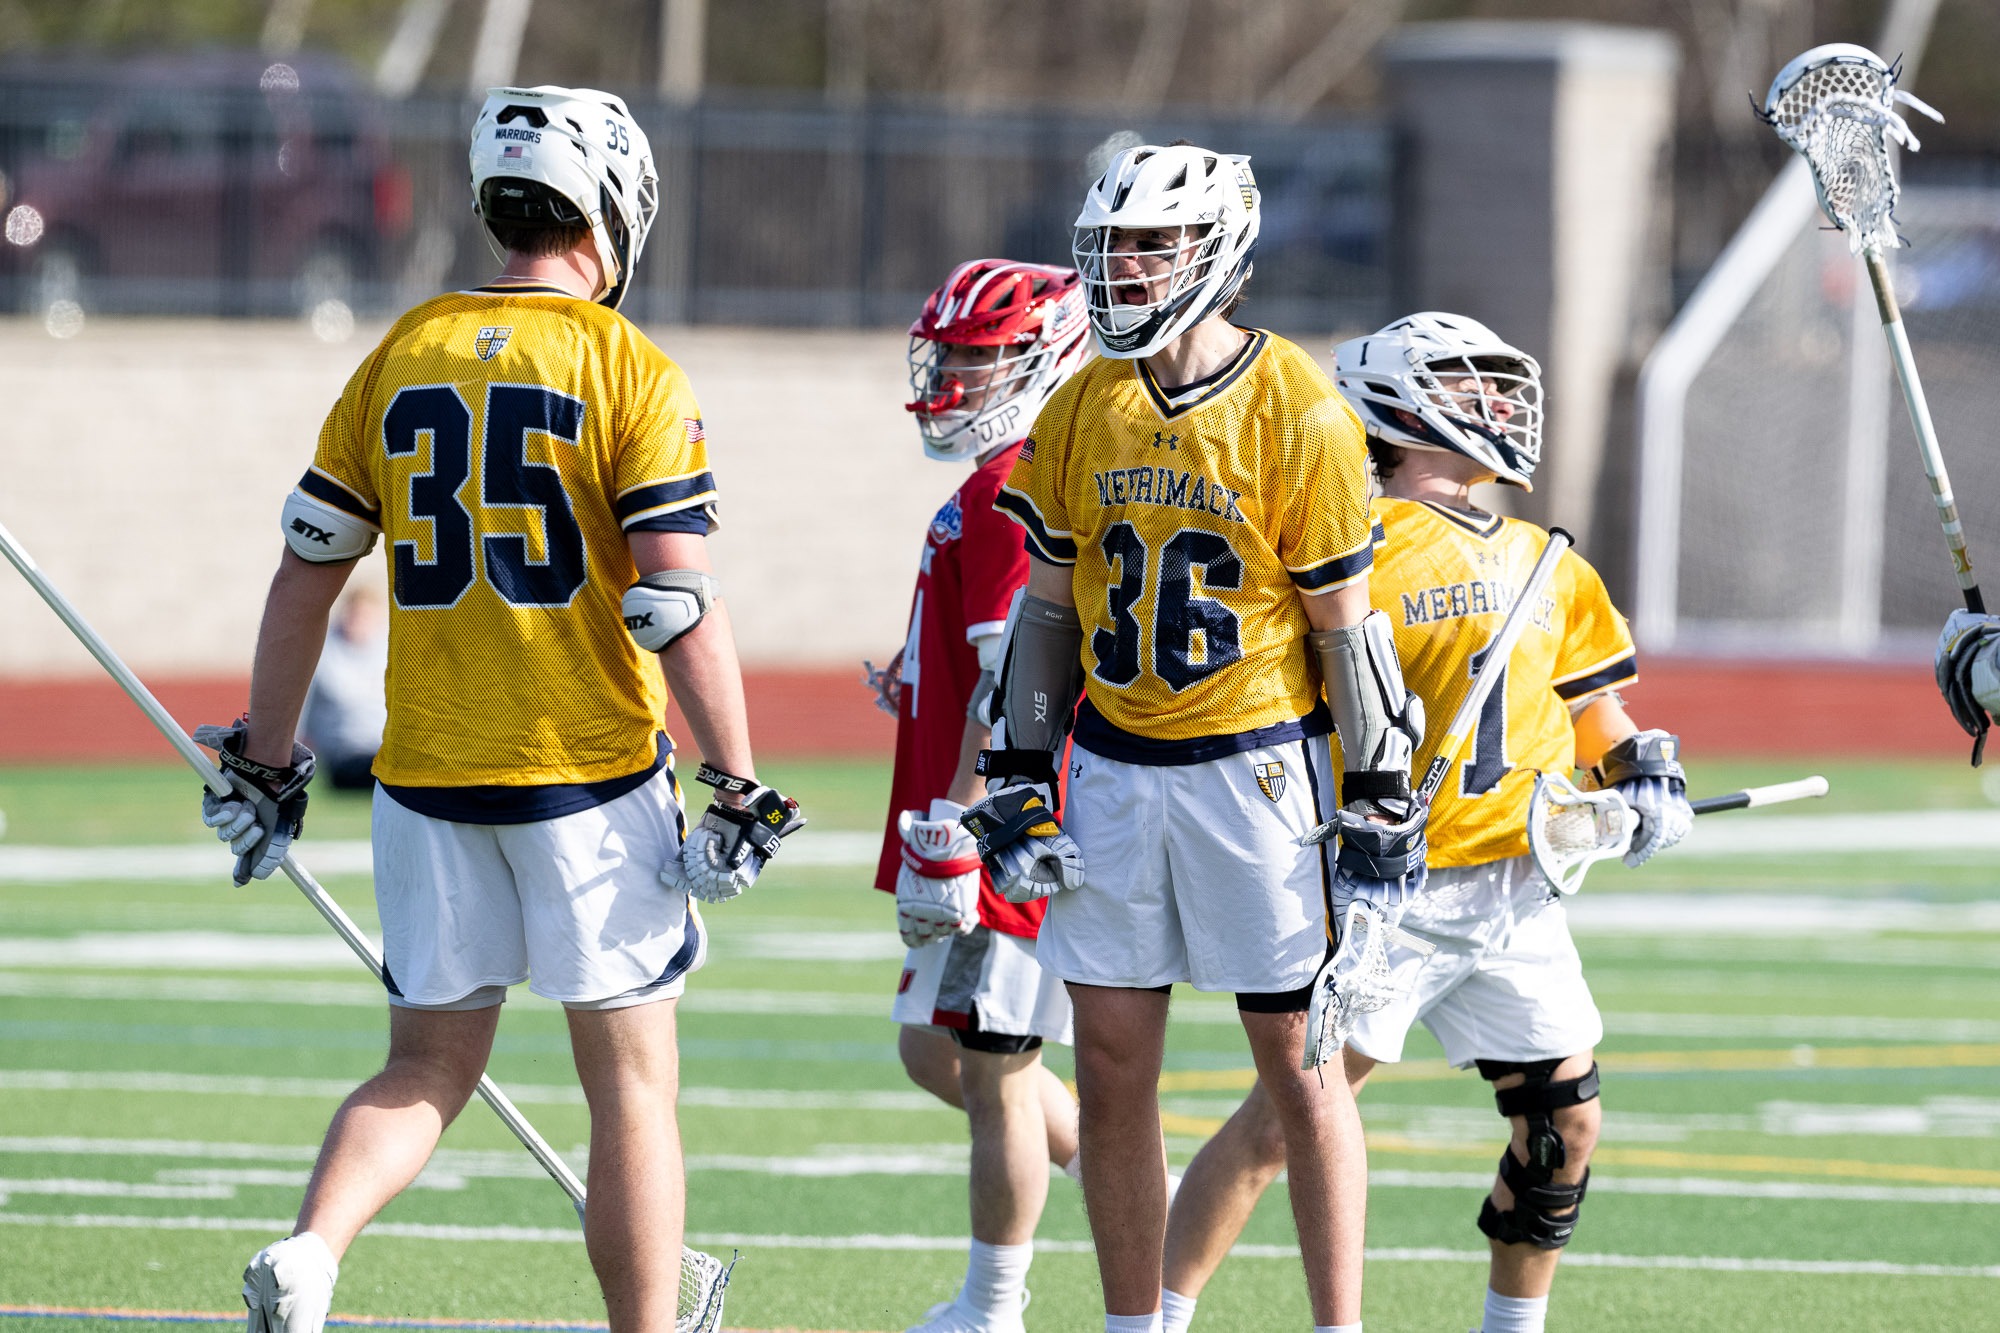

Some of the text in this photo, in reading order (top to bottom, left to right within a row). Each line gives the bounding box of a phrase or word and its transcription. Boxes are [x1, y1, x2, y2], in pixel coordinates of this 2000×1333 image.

[495, 128, 542, 144] WARRIORS
[605, 119, 629, 156] 35
[979, 405, 1020, 442] JJP
[381, 382, 588, 610] 35
[289, 517, 336, 545] STX
[1045, 610, 1063, 620] RIGHT
[1090, 520, 1245, 694] 36
[1034, 690, 1048, 724] STX
[220, 748, 281, 780] SURGE
[697, 767, 747, 791] SURG
[766, 809, 784, 825] 35
[735, 840, 753, 864] STX
